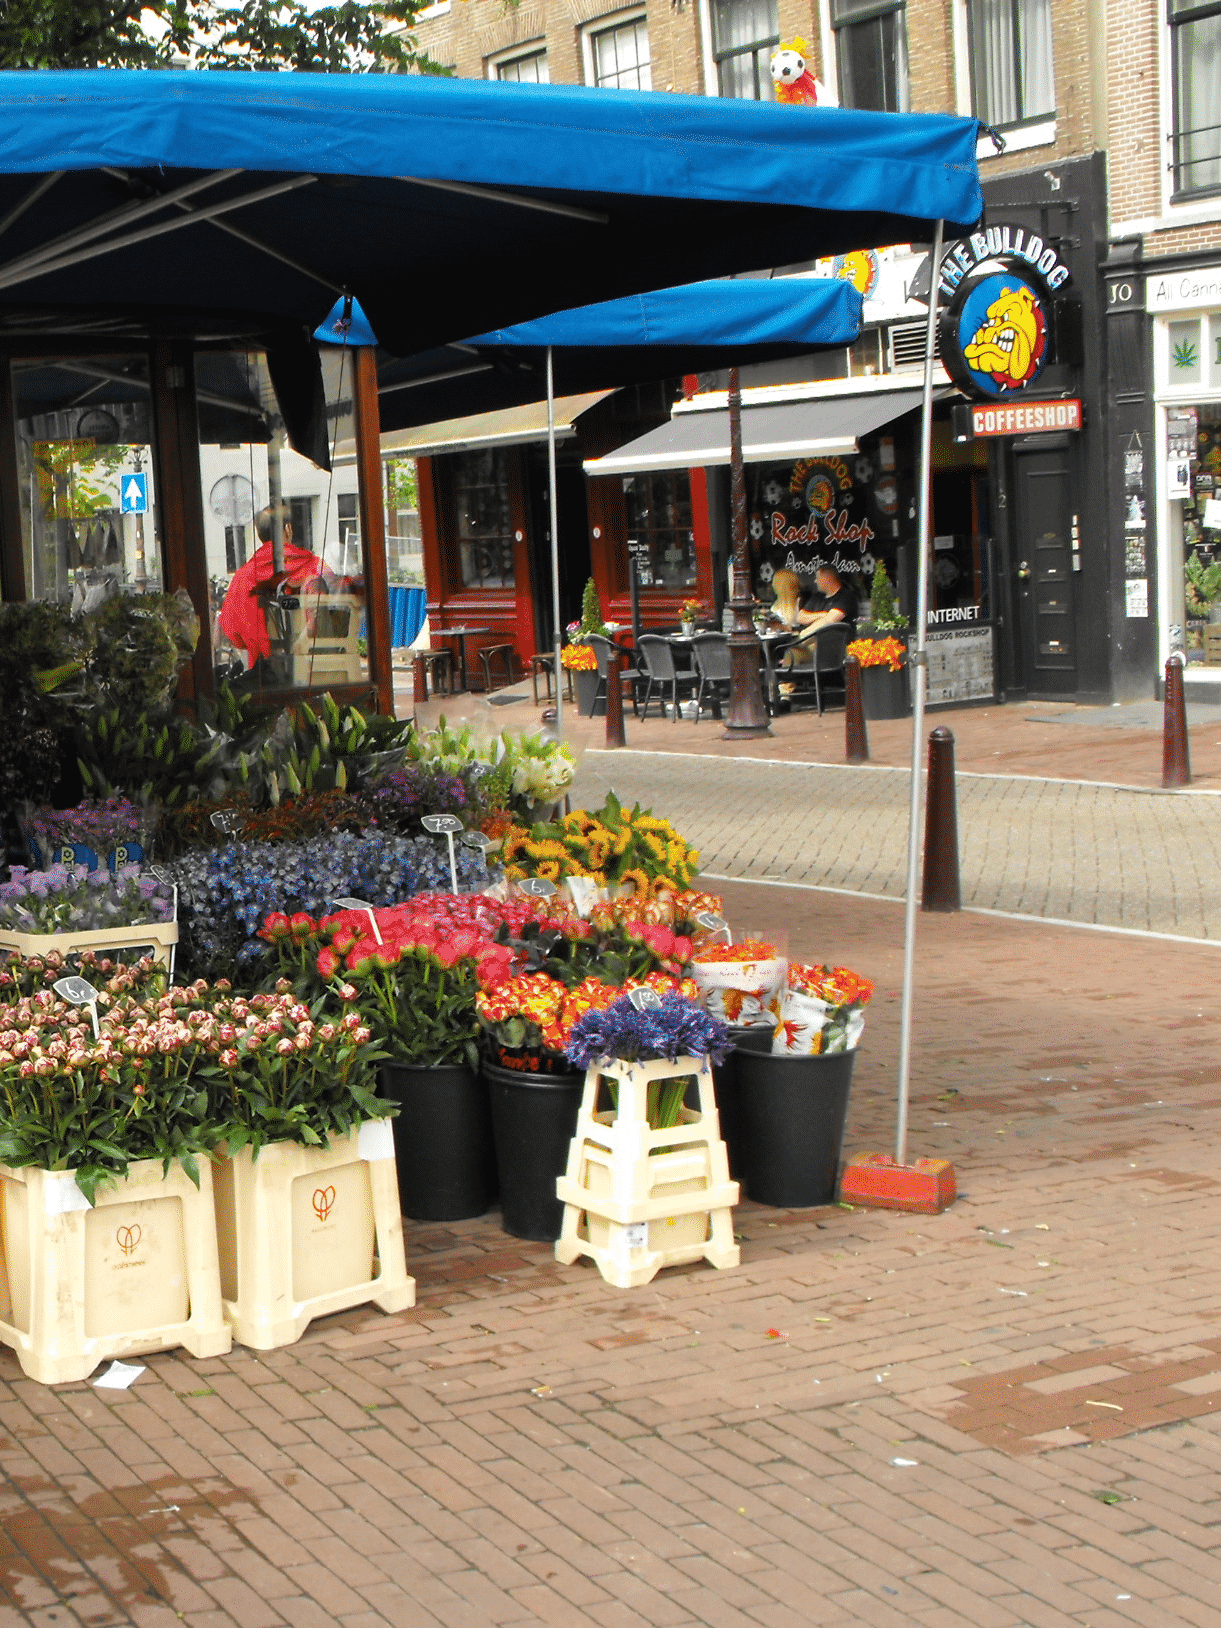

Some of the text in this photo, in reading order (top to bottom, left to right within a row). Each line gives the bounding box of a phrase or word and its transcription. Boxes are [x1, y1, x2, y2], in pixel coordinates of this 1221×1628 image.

[938, 226, 1070, 297] THE BULLDOG
[1156, 281, 1173, 301] All
[973, 405, 1078, 433] COFFEESHOP
[771, 508, 874, 553] Rock Shop
[927, 605, 980, 624] INTERNET
